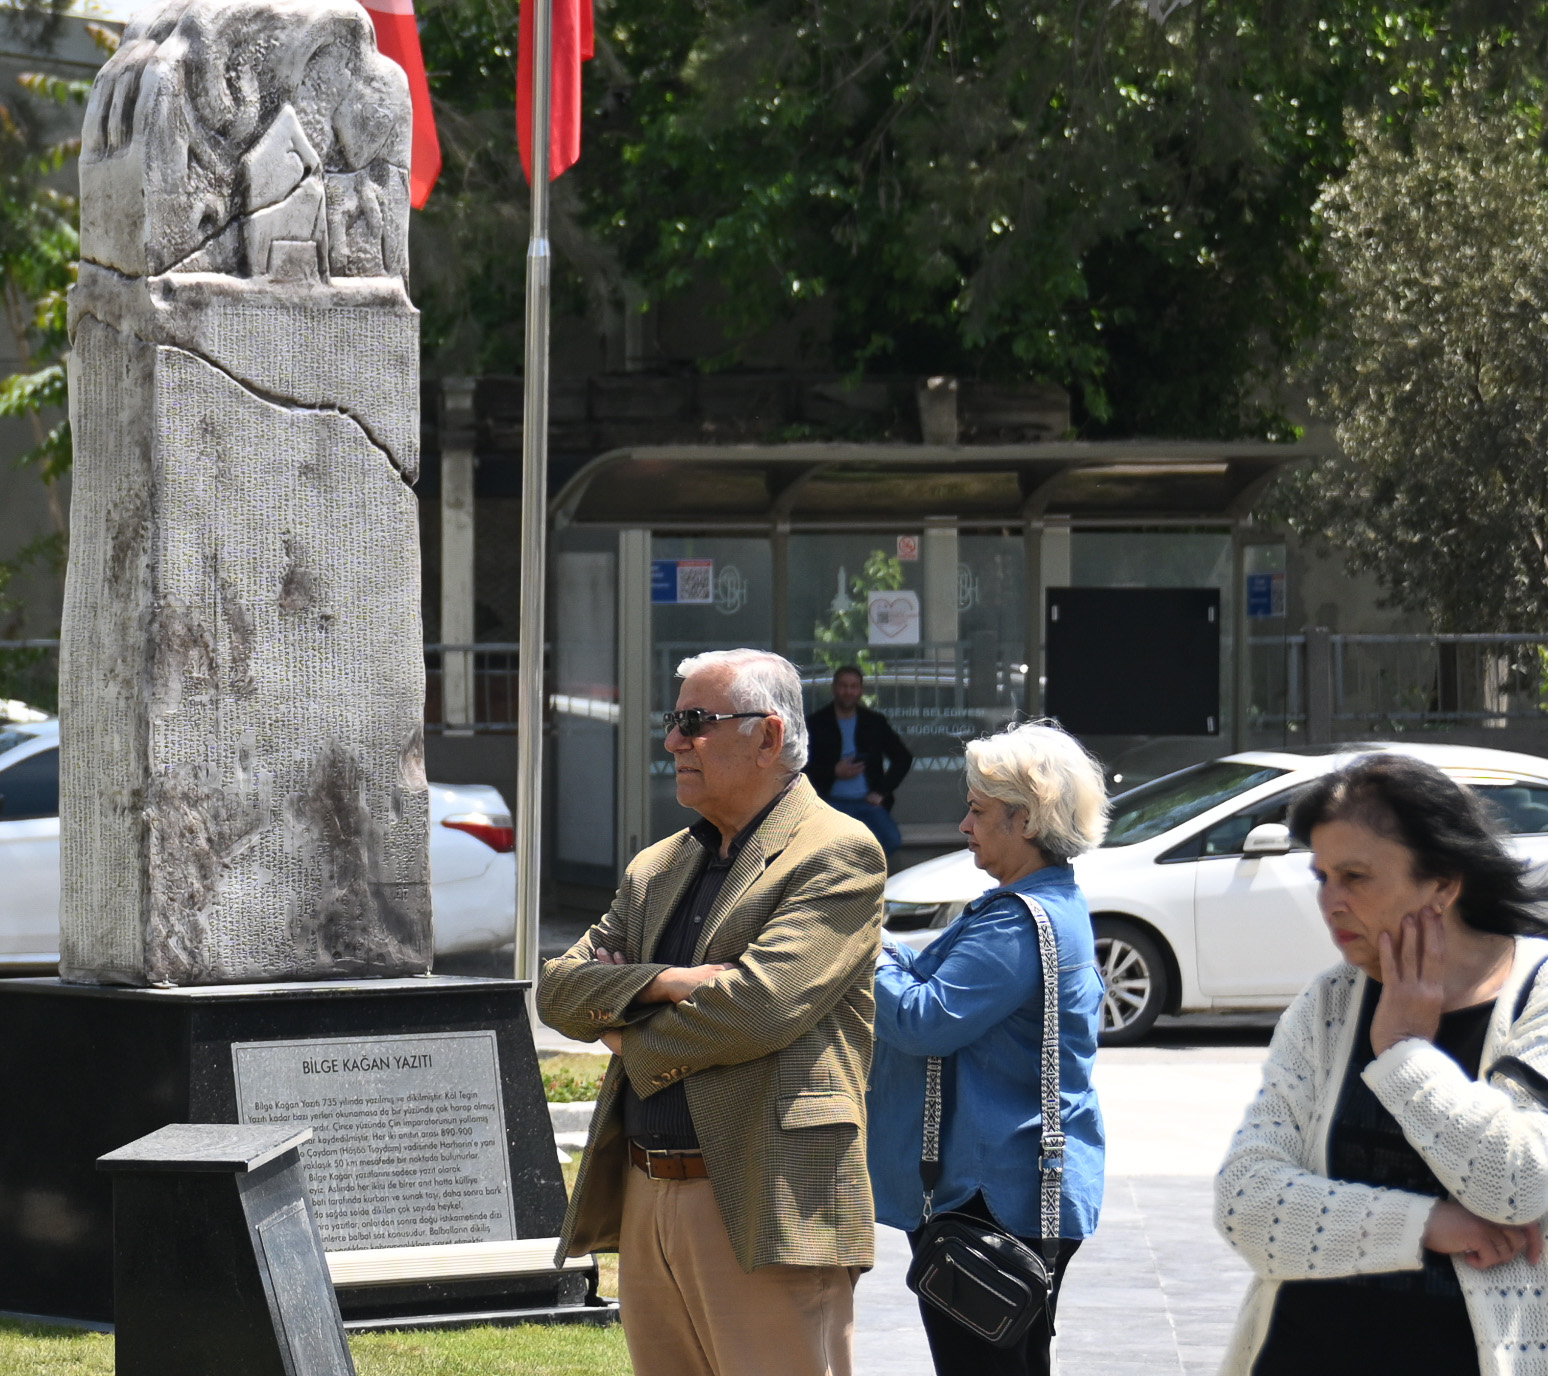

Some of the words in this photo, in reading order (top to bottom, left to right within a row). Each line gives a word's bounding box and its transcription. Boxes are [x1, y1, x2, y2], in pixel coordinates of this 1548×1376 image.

[303, 1056, 338, 1074] BİLGE
[343, 1054, 390, 1072] KAĞAN
[393, 1054, 433, 1069] YAZITI
[255, 1101, 273, 1112] Bilge
[323, 1098, 337, 1106] 735
[339, 1096, 363, 1107] yılında
[459, 1091, 477, 1100] Tegin
[269, 1114, 290, 1122] kadar
[293, 1113, 308, 1121] bazı
[310, 1112, 333, 1122] yerleri
[335, 1108, 378, 1119] okunamasa
[392, 1106, 401, 1115] bir
[403, 1105, 434, 1116] yüzünde
[436, 1105, 448, 1114] çok
[450, 1103, 472, 1112] harap
[474, 1102, 495, 1111] olmuş
[333, 1122, 353, 1133] Çince
[356, 1119, 386, 1132] yüzünde
[388, 1118, 401, 1129] Çin
[403, 1115, 457, 1128] imparatorunun
[459, 1114, 488, 1125] yollamış
[372, 1132, 386, 1140] Her
[441, 1127, 473, 1137] 890-900
[404, 1141, 438, 1151] vadisinde
[481, 1138, 495, 1148] yani
[334, 1159, 344, 1168] 50
[360, 1156, 394, 1166] mesafede
[397, 1155, 406, 1164] bir
[409, 1153, 438, 1163] noktada
[441, 1151, 479, 1161] bulunurlar.
[309, 1173, 327, 1183] Bilge
[329, 1172, 352, 1182] Kağan
[392, 1167, 417, 1177] sadece
[419, 1166, 436, 1176] yazıt
[438, 1164, 461, 1174] olarak
[328, 1183, 355, 1193] Aslında
[357, 1183, 369, 1191] her
[372, 1181, 385, 1190] ikisi
[388, 1181, 396, 1189] de
[398, 1179, 415, 1188] birer
[418, 1178, 432, 1187] anıt
[434, 1177, 453, 1186] hatta
[455, 1175, 478, 1186] külliye
[328, 1196, 361, 1205] tarafında
[364, 1194, 390, 1203] kurban
[402, 1191, 423, 1200] sunak
[425, 1190, 441, 1200] taşı,
[443, 1189, 461, 1198] daha
[463, 1188, 483, 1196] sonra
[485, 1185, 502, 1195] bark
[326, 1209, 347, 1219] sağda
[350, 1207, 369, 1217] solda
[398, 1204, 411, 1214] çok
[413, 1203, 435, 1213] sayıda
[438, 1201, 464, 1211] heykel,
[361, 1218, 395, 1228] onlardan
[419, 1214, 437, 1225] doğu
[440, 1211, 487, 1222] istikametinde
[489, 1210, 502, 1218] dizi
[349, 1231, 372, 1241] balbal
[373, 1231, 385, 1239] söz
[387, 1228, 427, 1238] konusudur.
[470, 1223, 490, 1233] dikiliş
